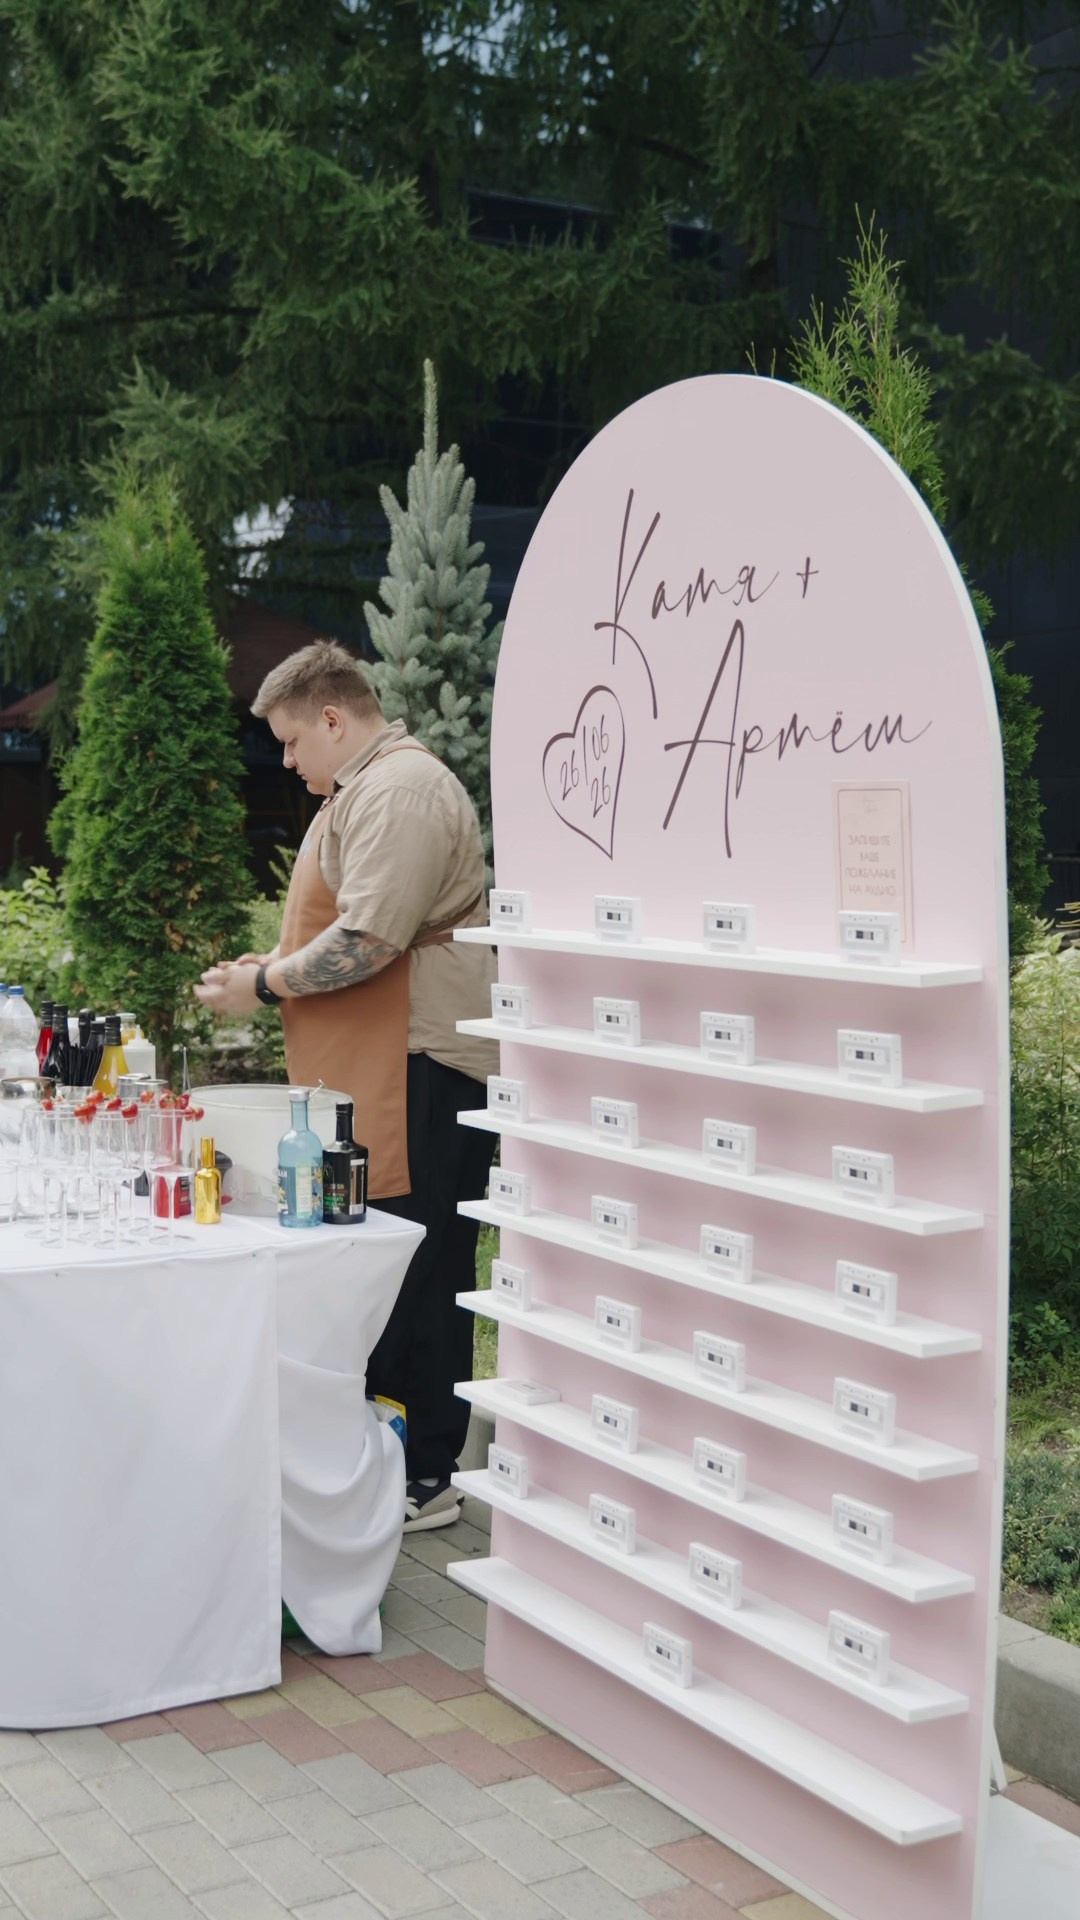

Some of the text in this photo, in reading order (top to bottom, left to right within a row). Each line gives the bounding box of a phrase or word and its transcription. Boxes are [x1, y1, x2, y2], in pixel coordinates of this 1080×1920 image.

[594, 488, 779, 719] Катя
[591, 766, 611, 818] 26
[662, 619, 932, 859] Артём
